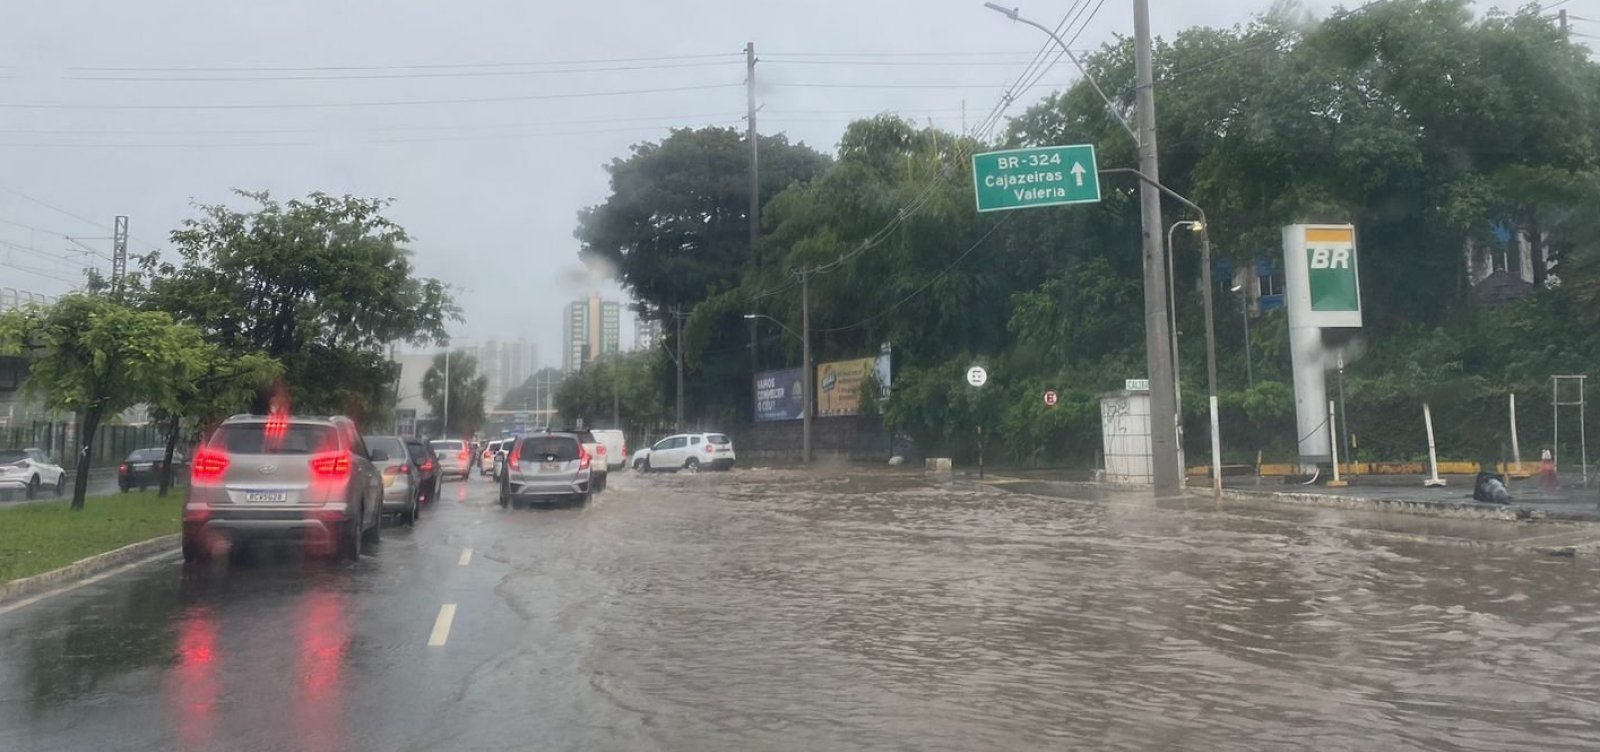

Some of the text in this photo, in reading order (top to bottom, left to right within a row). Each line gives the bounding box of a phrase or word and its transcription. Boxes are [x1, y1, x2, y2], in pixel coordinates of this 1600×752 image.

[998, 153, 1061, 169] BR-324
[985, 171, 1063, 189] Cajazeiras
[1311, 249, 1349, 269] BR
